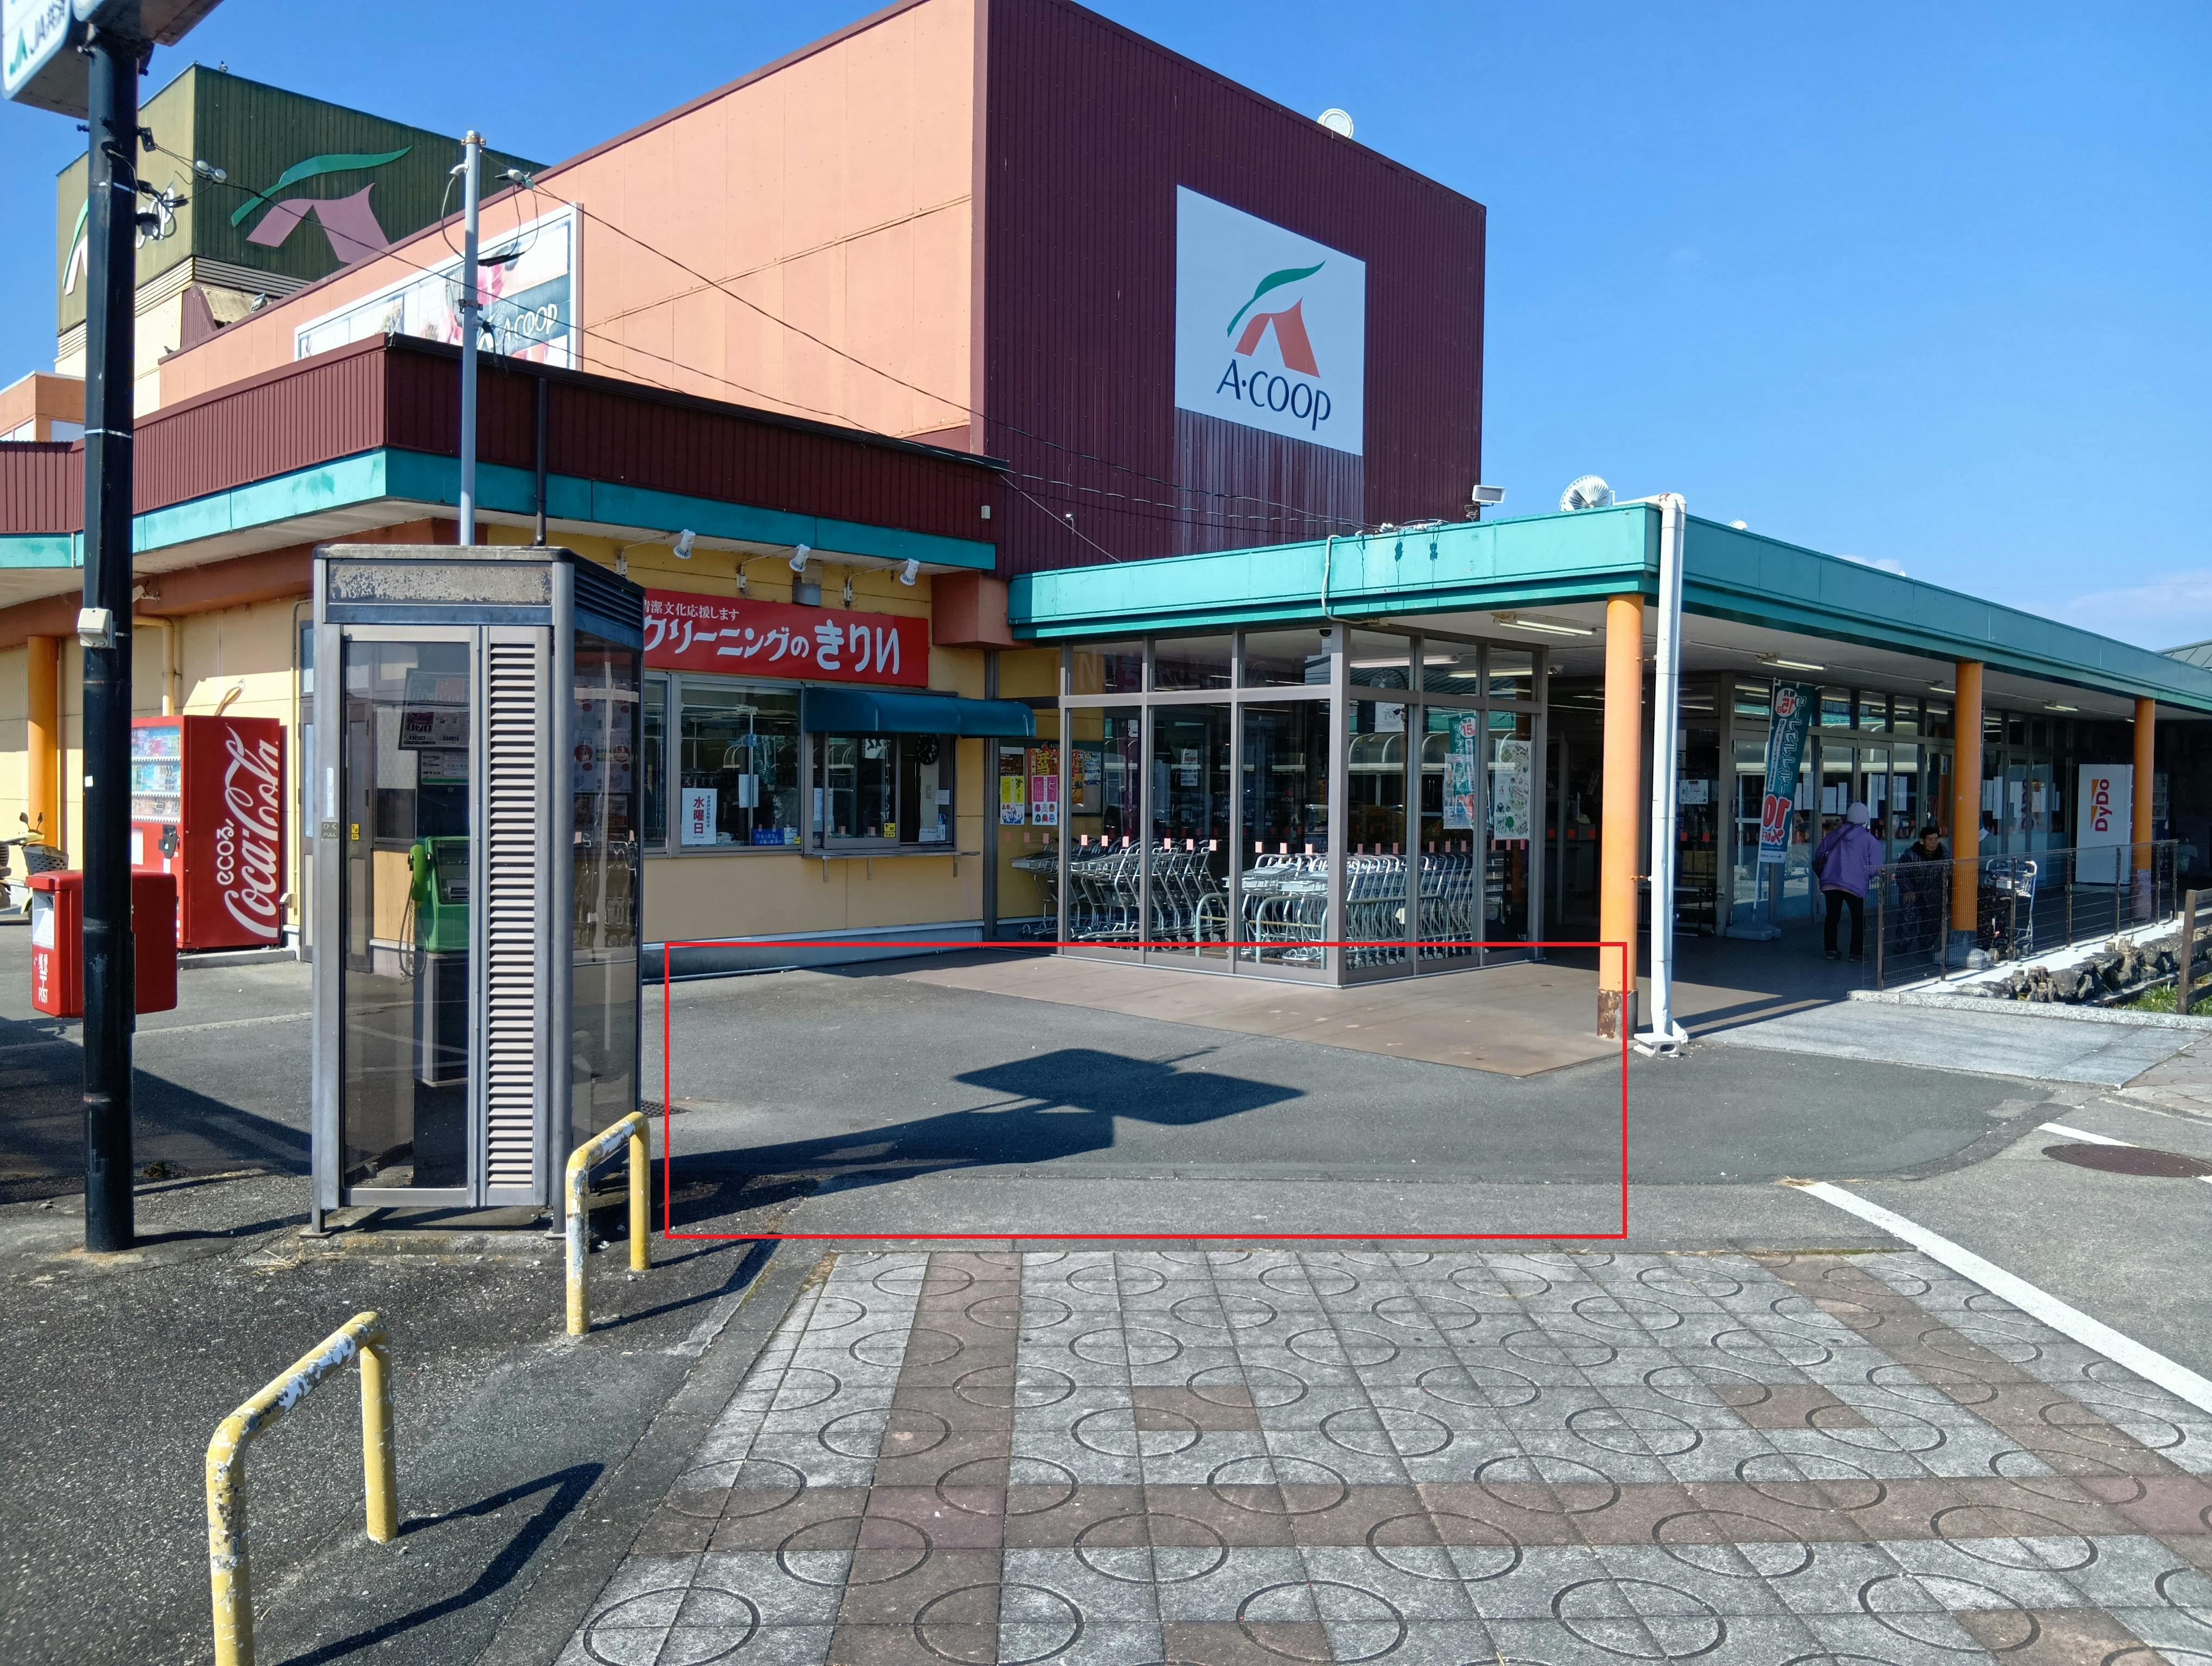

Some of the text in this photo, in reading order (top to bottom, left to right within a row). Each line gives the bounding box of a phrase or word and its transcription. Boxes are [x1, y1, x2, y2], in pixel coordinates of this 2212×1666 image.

[1216, 358, 1331, 431] A·COOP
[693, 796, 704, 834] 水曜日
[2094, 779, 2113, 831] DyDo
